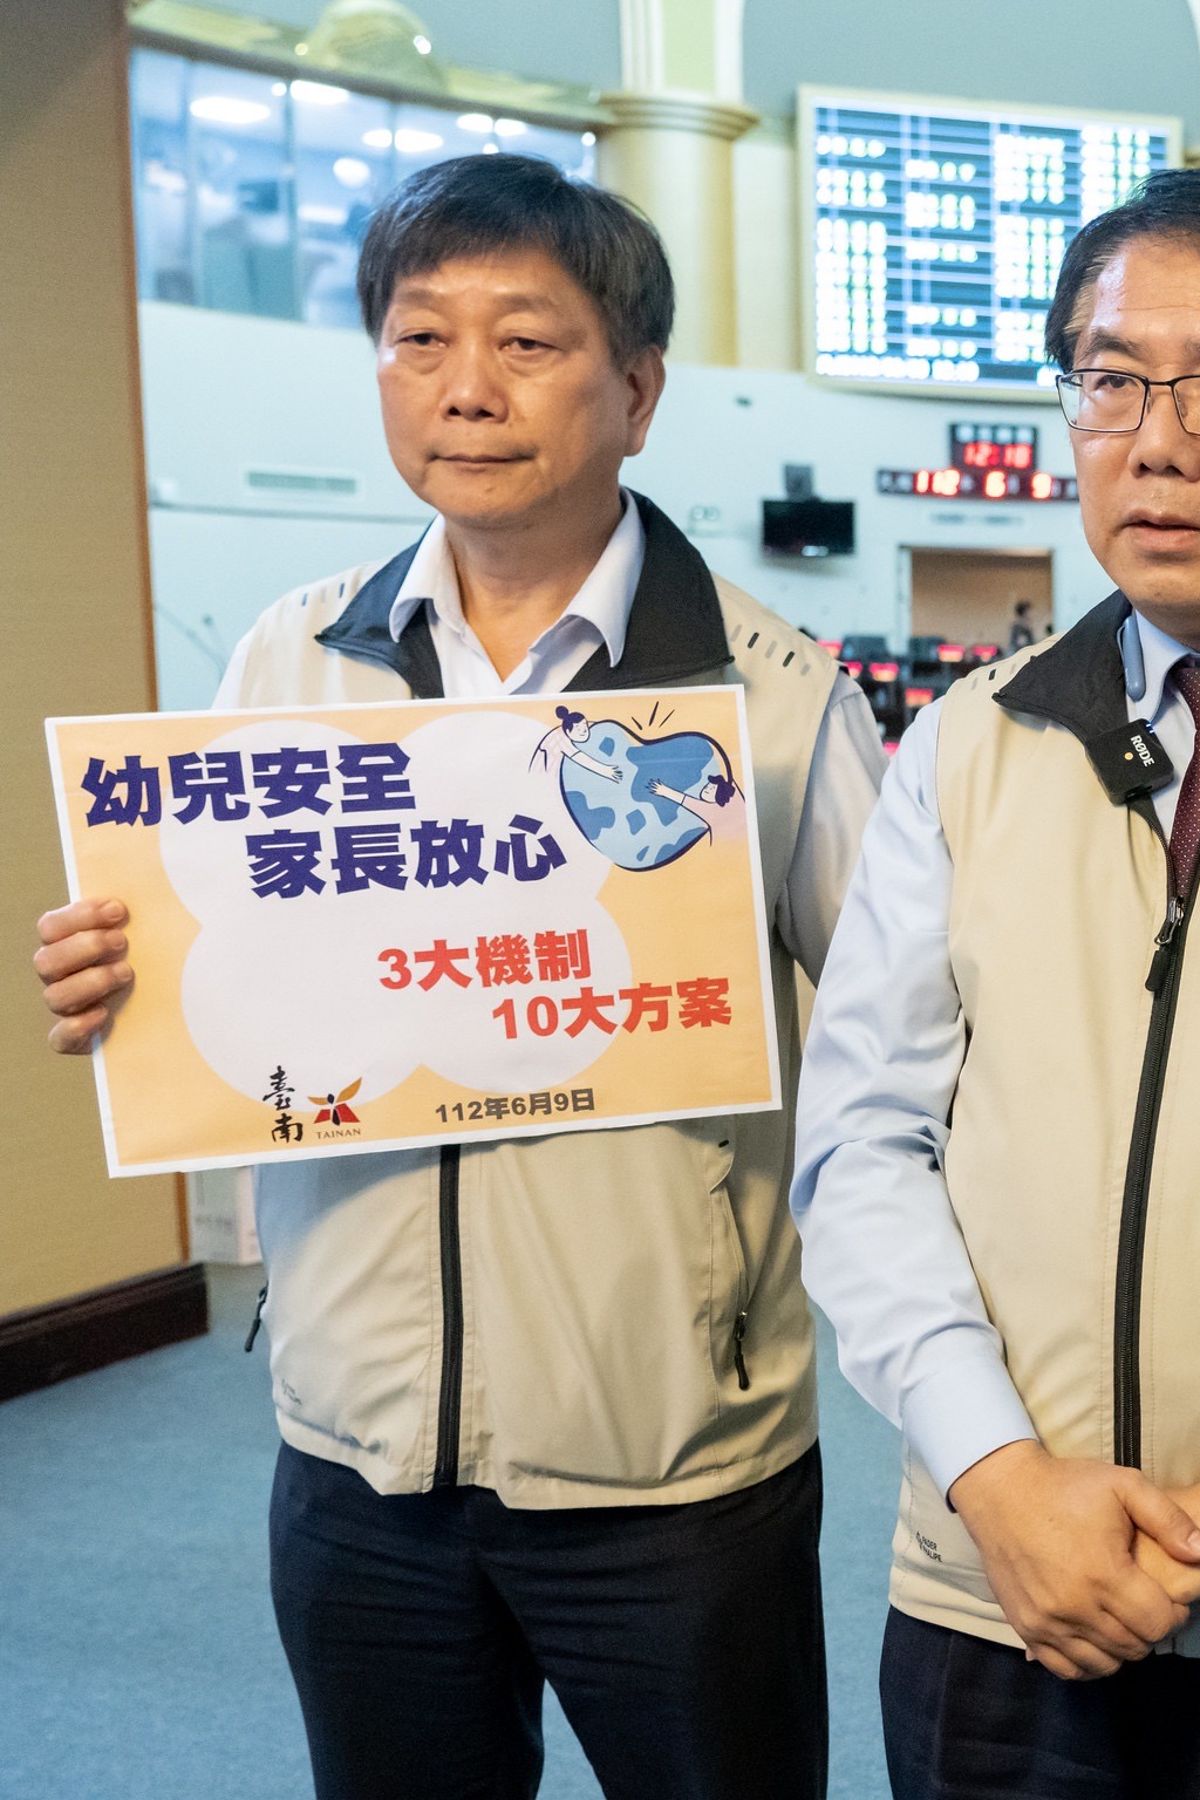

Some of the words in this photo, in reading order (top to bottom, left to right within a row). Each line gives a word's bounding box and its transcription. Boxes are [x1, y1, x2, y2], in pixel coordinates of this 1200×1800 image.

[1131, 735, 1155, 767] RØDE
[81, 742, 416, 828] 幼兒安全
[245, 814, 567, 899] 家長放心
[378, 928, 591, 992] 3大機制
[492, 976, 732, 1039] 10大方案
[263, 1065, 303, 1143] 臺南
[316, 1127, 362, 1140] TAINAN
[436, 1088, 596, 1123] 112年6月9日
